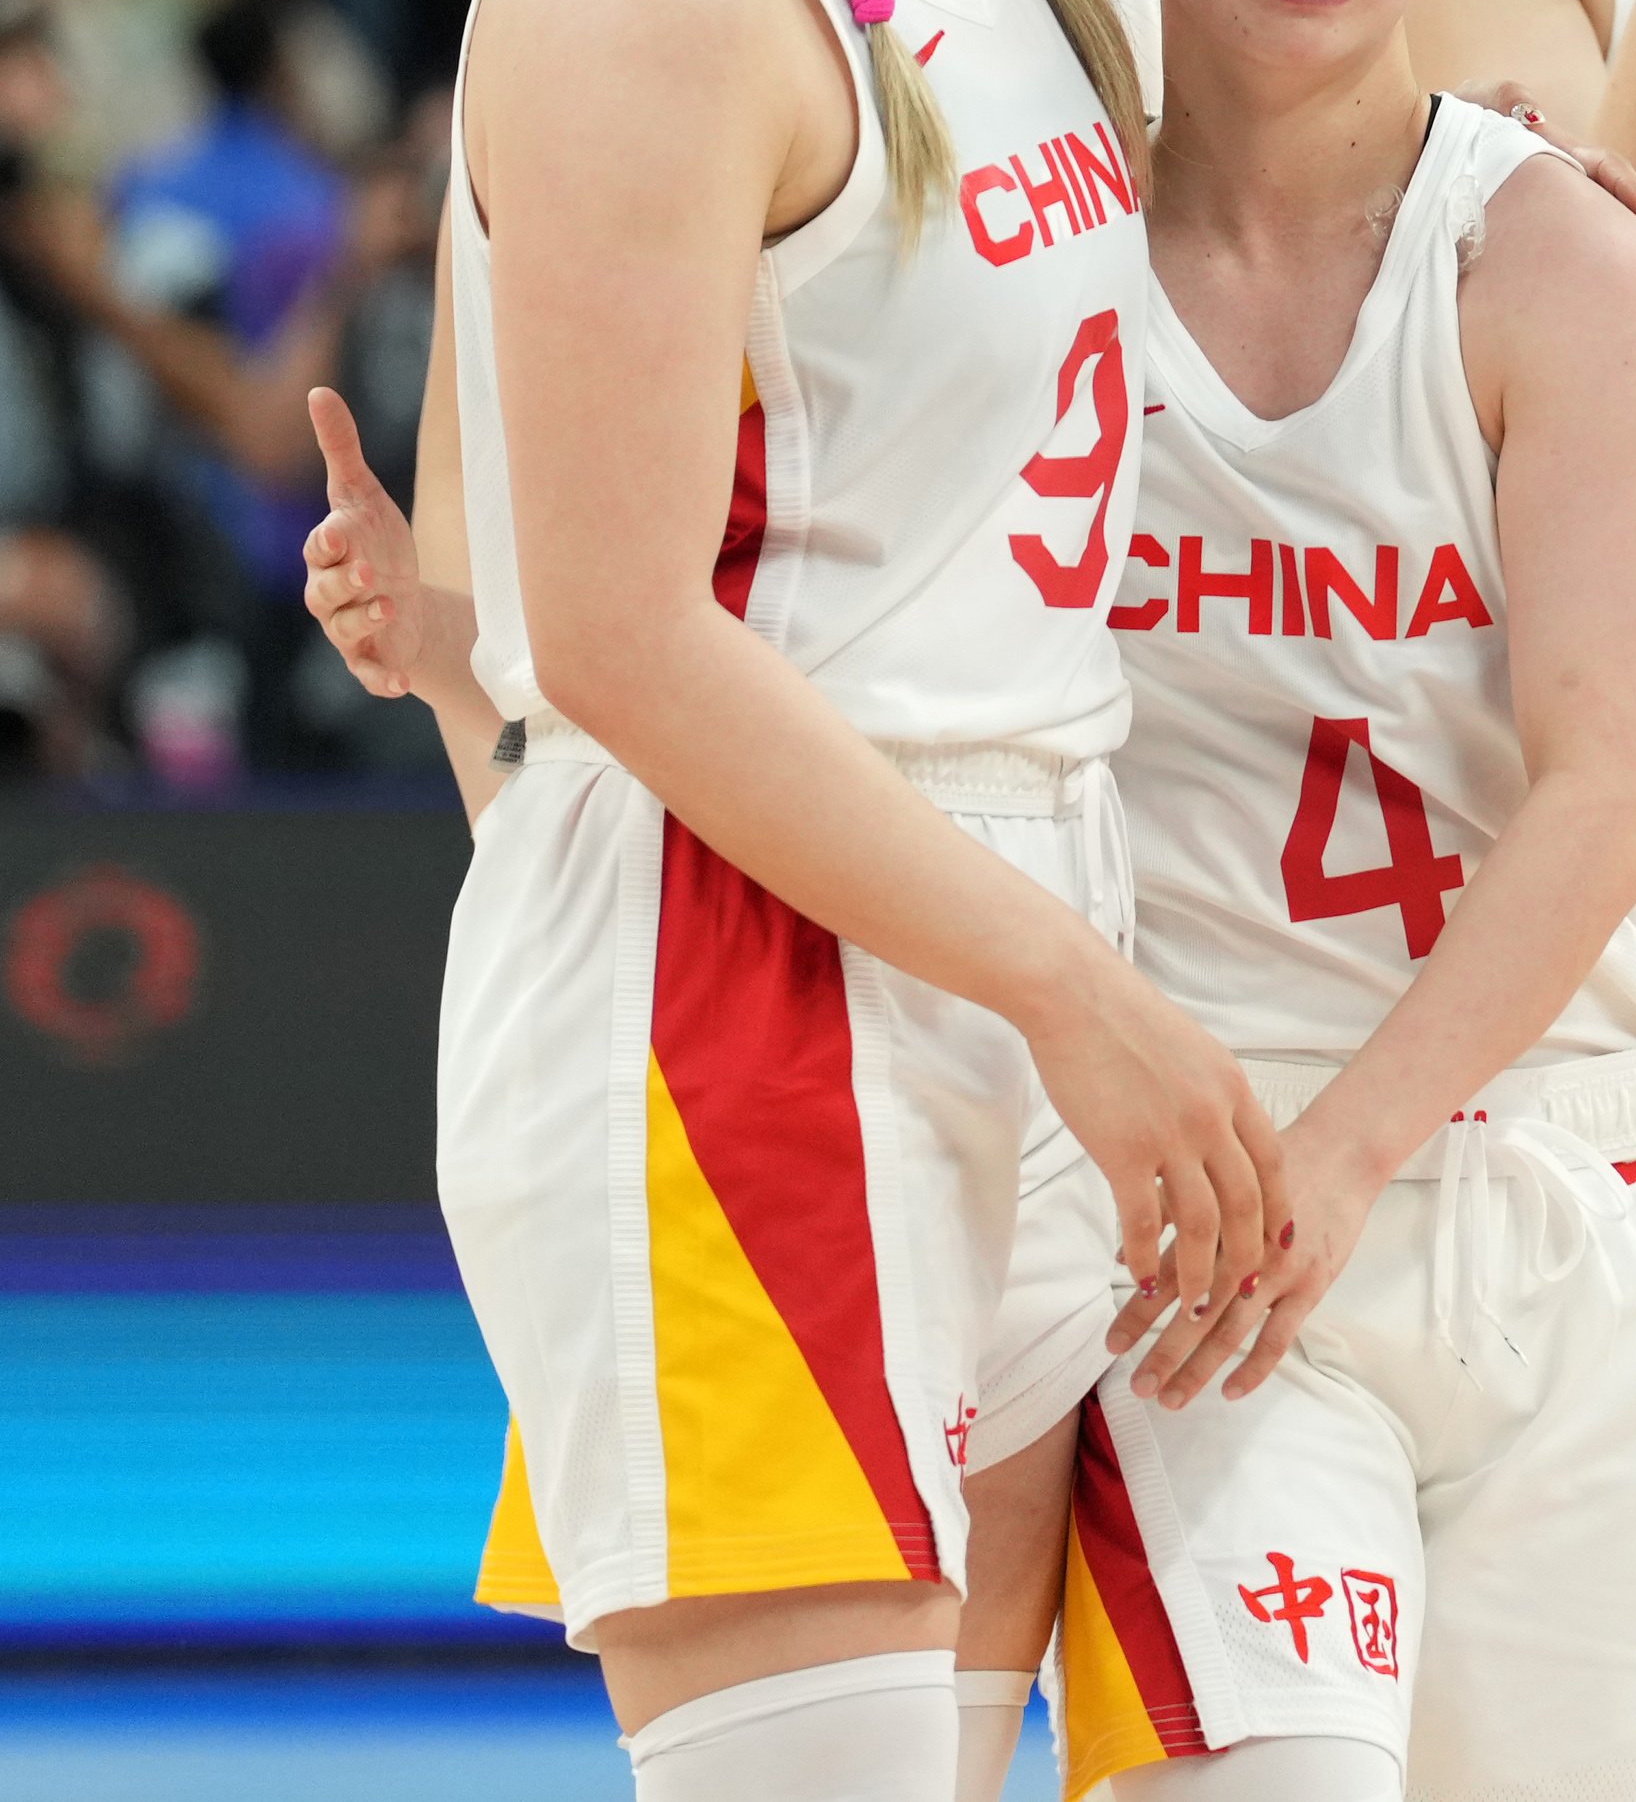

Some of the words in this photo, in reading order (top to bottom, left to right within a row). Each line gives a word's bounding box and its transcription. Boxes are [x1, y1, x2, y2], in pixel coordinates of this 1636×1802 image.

[959, 121, 1140, 268] CHIN
[1008, 308, 1130, 609] 9
[1105, 533, 1494, 641] CHINA
[1280, 714, 1466, 961] 4
[1237, 1550, 1400, 1683] 中国
